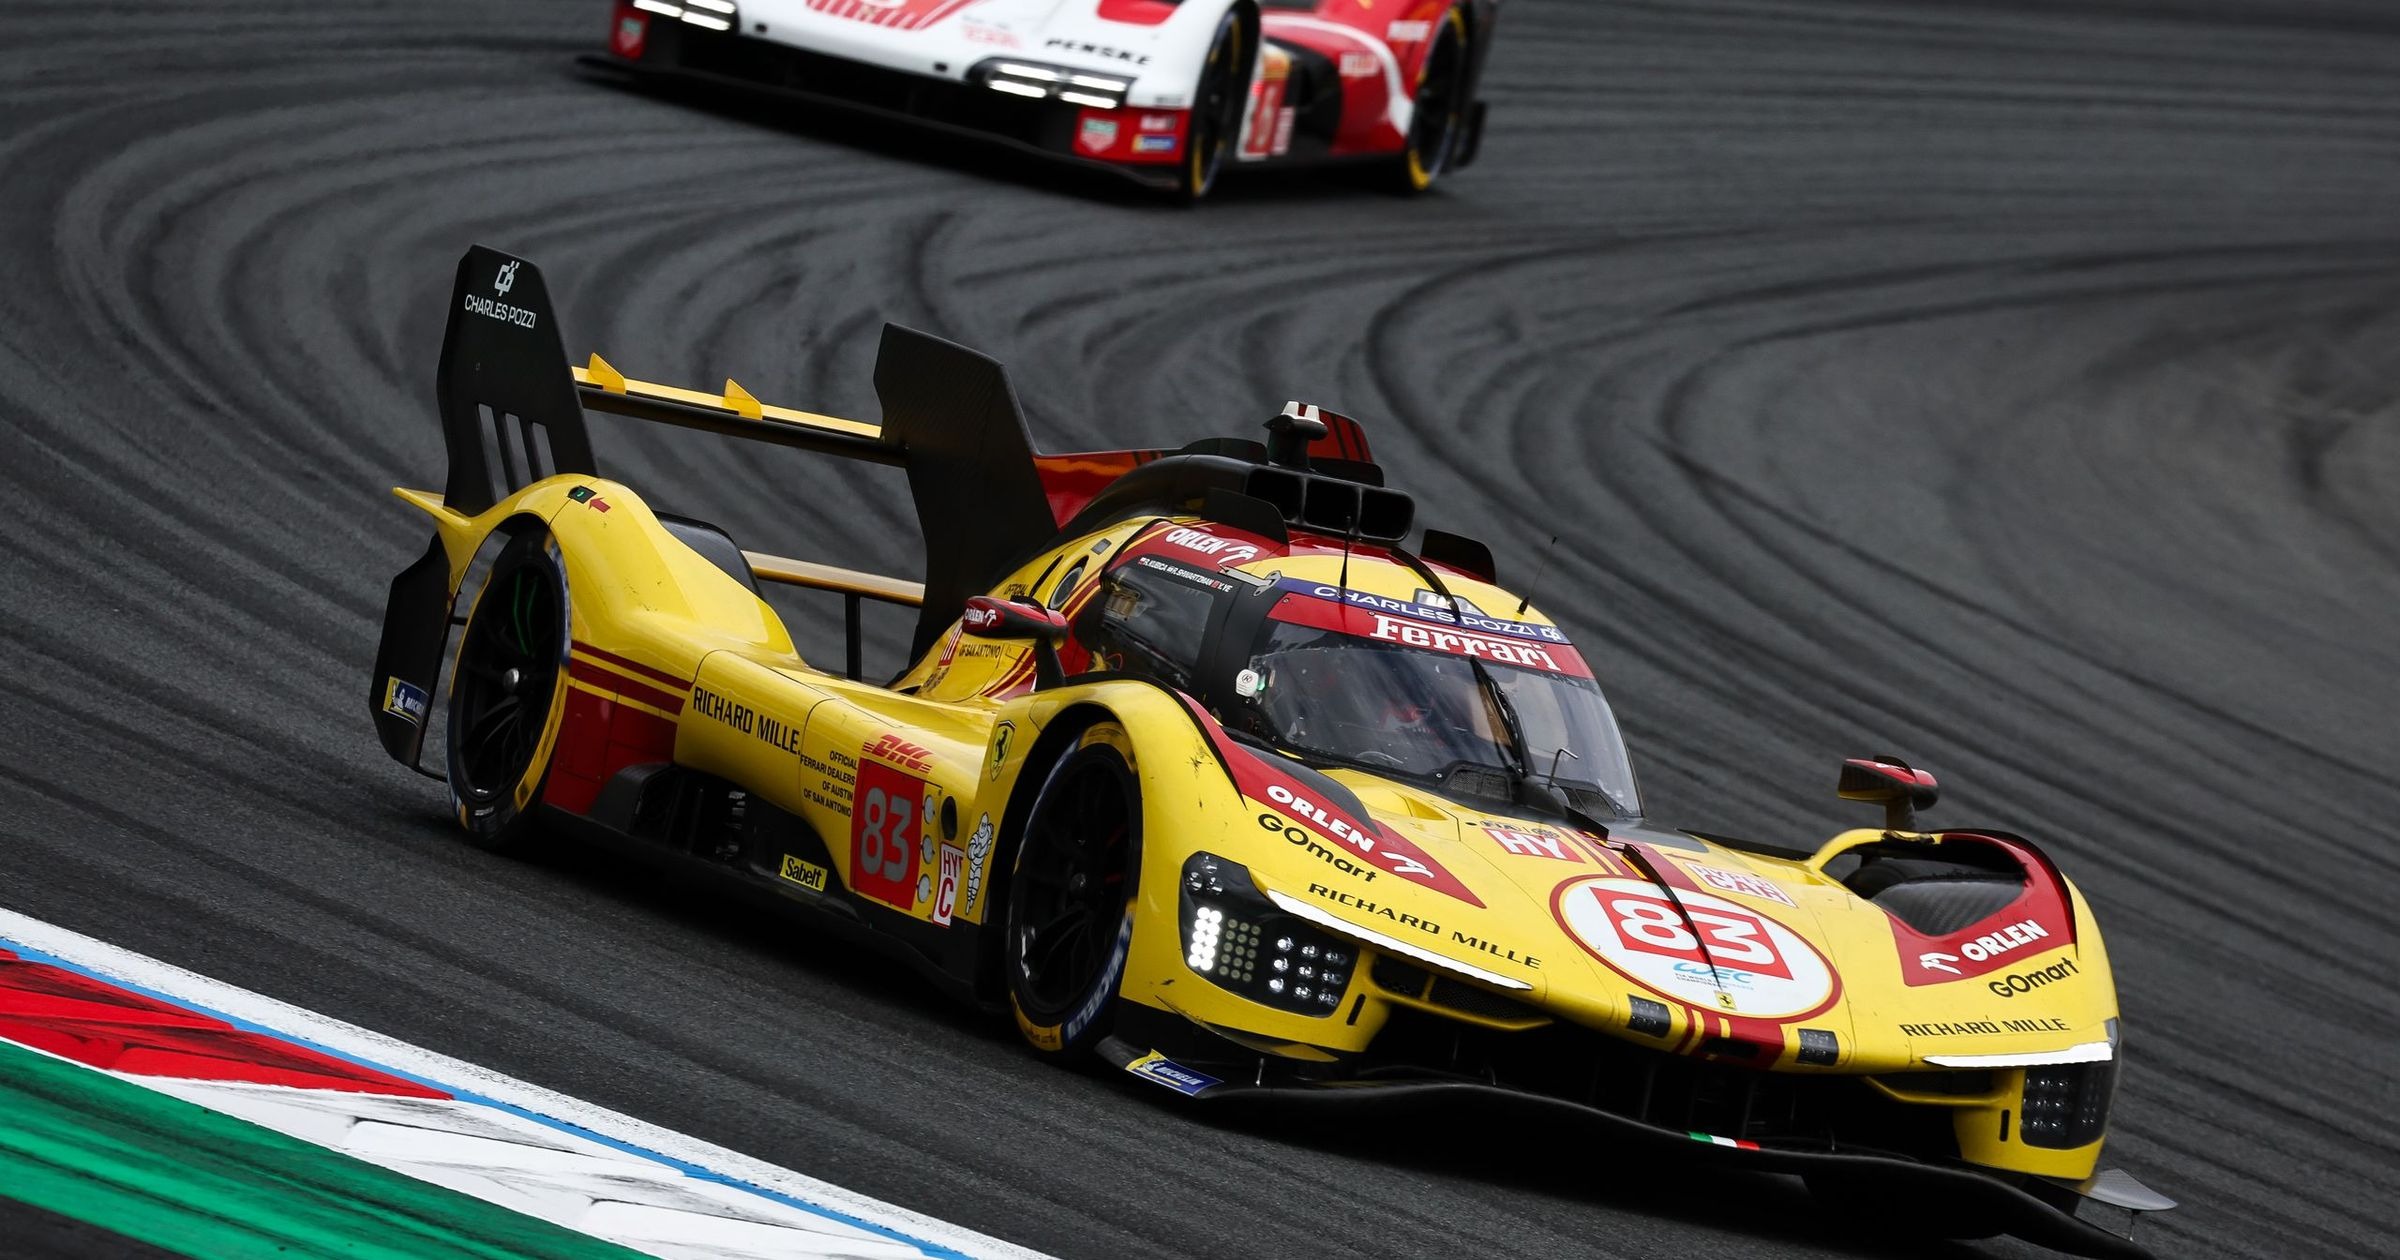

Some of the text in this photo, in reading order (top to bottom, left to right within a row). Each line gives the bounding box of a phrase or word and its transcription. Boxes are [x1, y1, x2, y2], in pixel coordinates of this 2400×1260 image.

[1045, 37, 1152, 66] PENSKE
[464, 294, 537, 329] CHARLES POZZI
[1165, 527, 1228, 554] ORLEN
[964, 608, 985, 623] ORLEN
[1313, 585, 1536, 637] CHARLES POZZI
[1370, 614, 1562, 671] Ferrari
[693, 685, 752, 734] RICHARD
[829, 750, 857, 770] OFFICIAL
[871, 733, 934, 769] DHL
[800, 754, 856, 786] FERRARI DEALERS
[803, 788, 852, 818] OF SAN ANTONIO
[822, 780, 854, 802] OF AUSTIN
[859, 787, 914, 883] 83
[1265, 785, 1376, 853] ORLEN
[1257, 813, 1378, 882] GOmart
[1487, 829, 1568, 860] HY
[785, 857, 822, 888] Sabelt
[1704, 873, 1789, 903] CAR
[1307, 882, 1543, 970] RICHARD MILLE
[1610, 898, 1776, 966] 83
[1960, 919, 2049, 962] ORLEN
[1673, 962, 1754, 984] WEC
[1988, 956, 2079, 998] GOmart
[1899, 1018, 2071, 1037] RICHARD MILLE
[1153, 1066, 1204, 1086] MICHELIN
